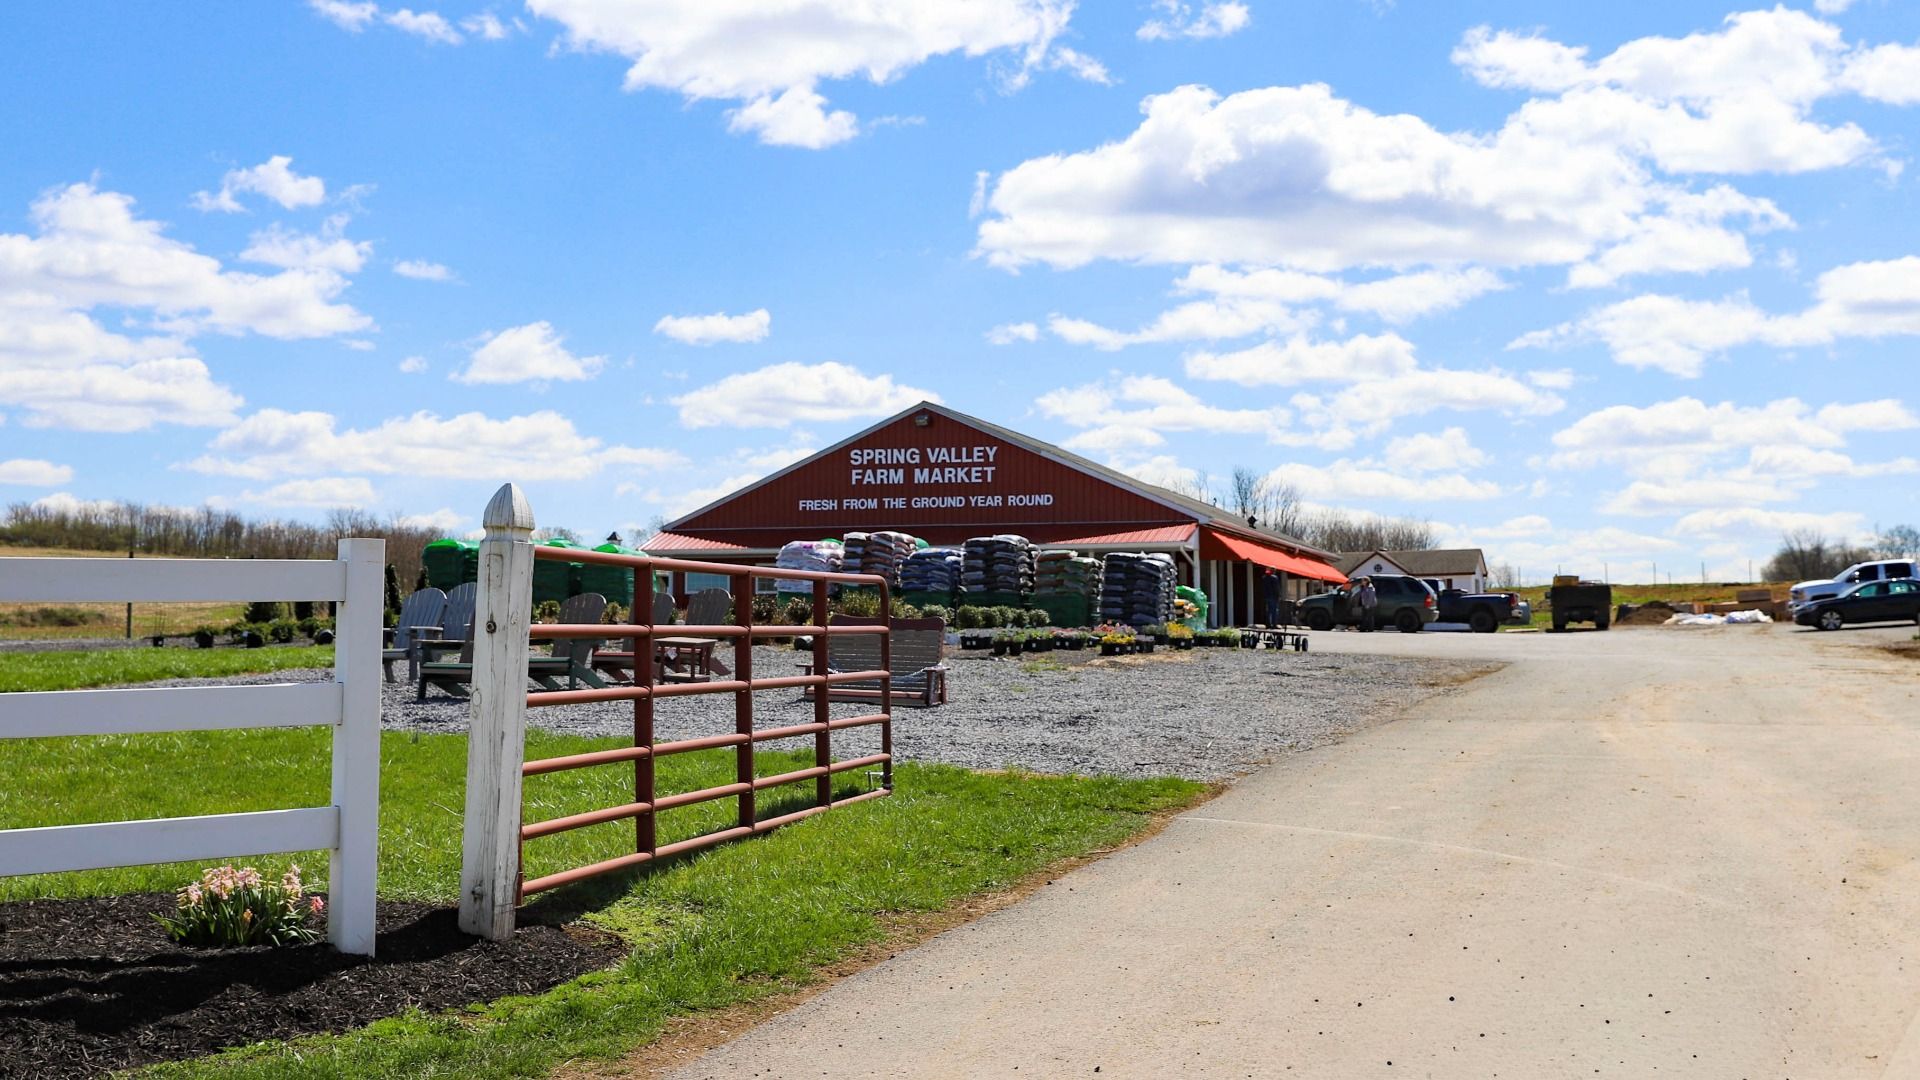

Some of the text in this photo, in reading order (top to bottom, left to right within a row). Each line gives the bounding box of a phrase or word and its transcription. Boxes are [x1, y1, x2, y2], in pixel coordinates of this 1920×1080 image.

[850, 446, 998, 465] SPRING VALLEY
[851, 466, 995, 485] FARM MARKET
[799, 494, 1054, 511] FRESH FROM THE GROUND YEAR ROUND
